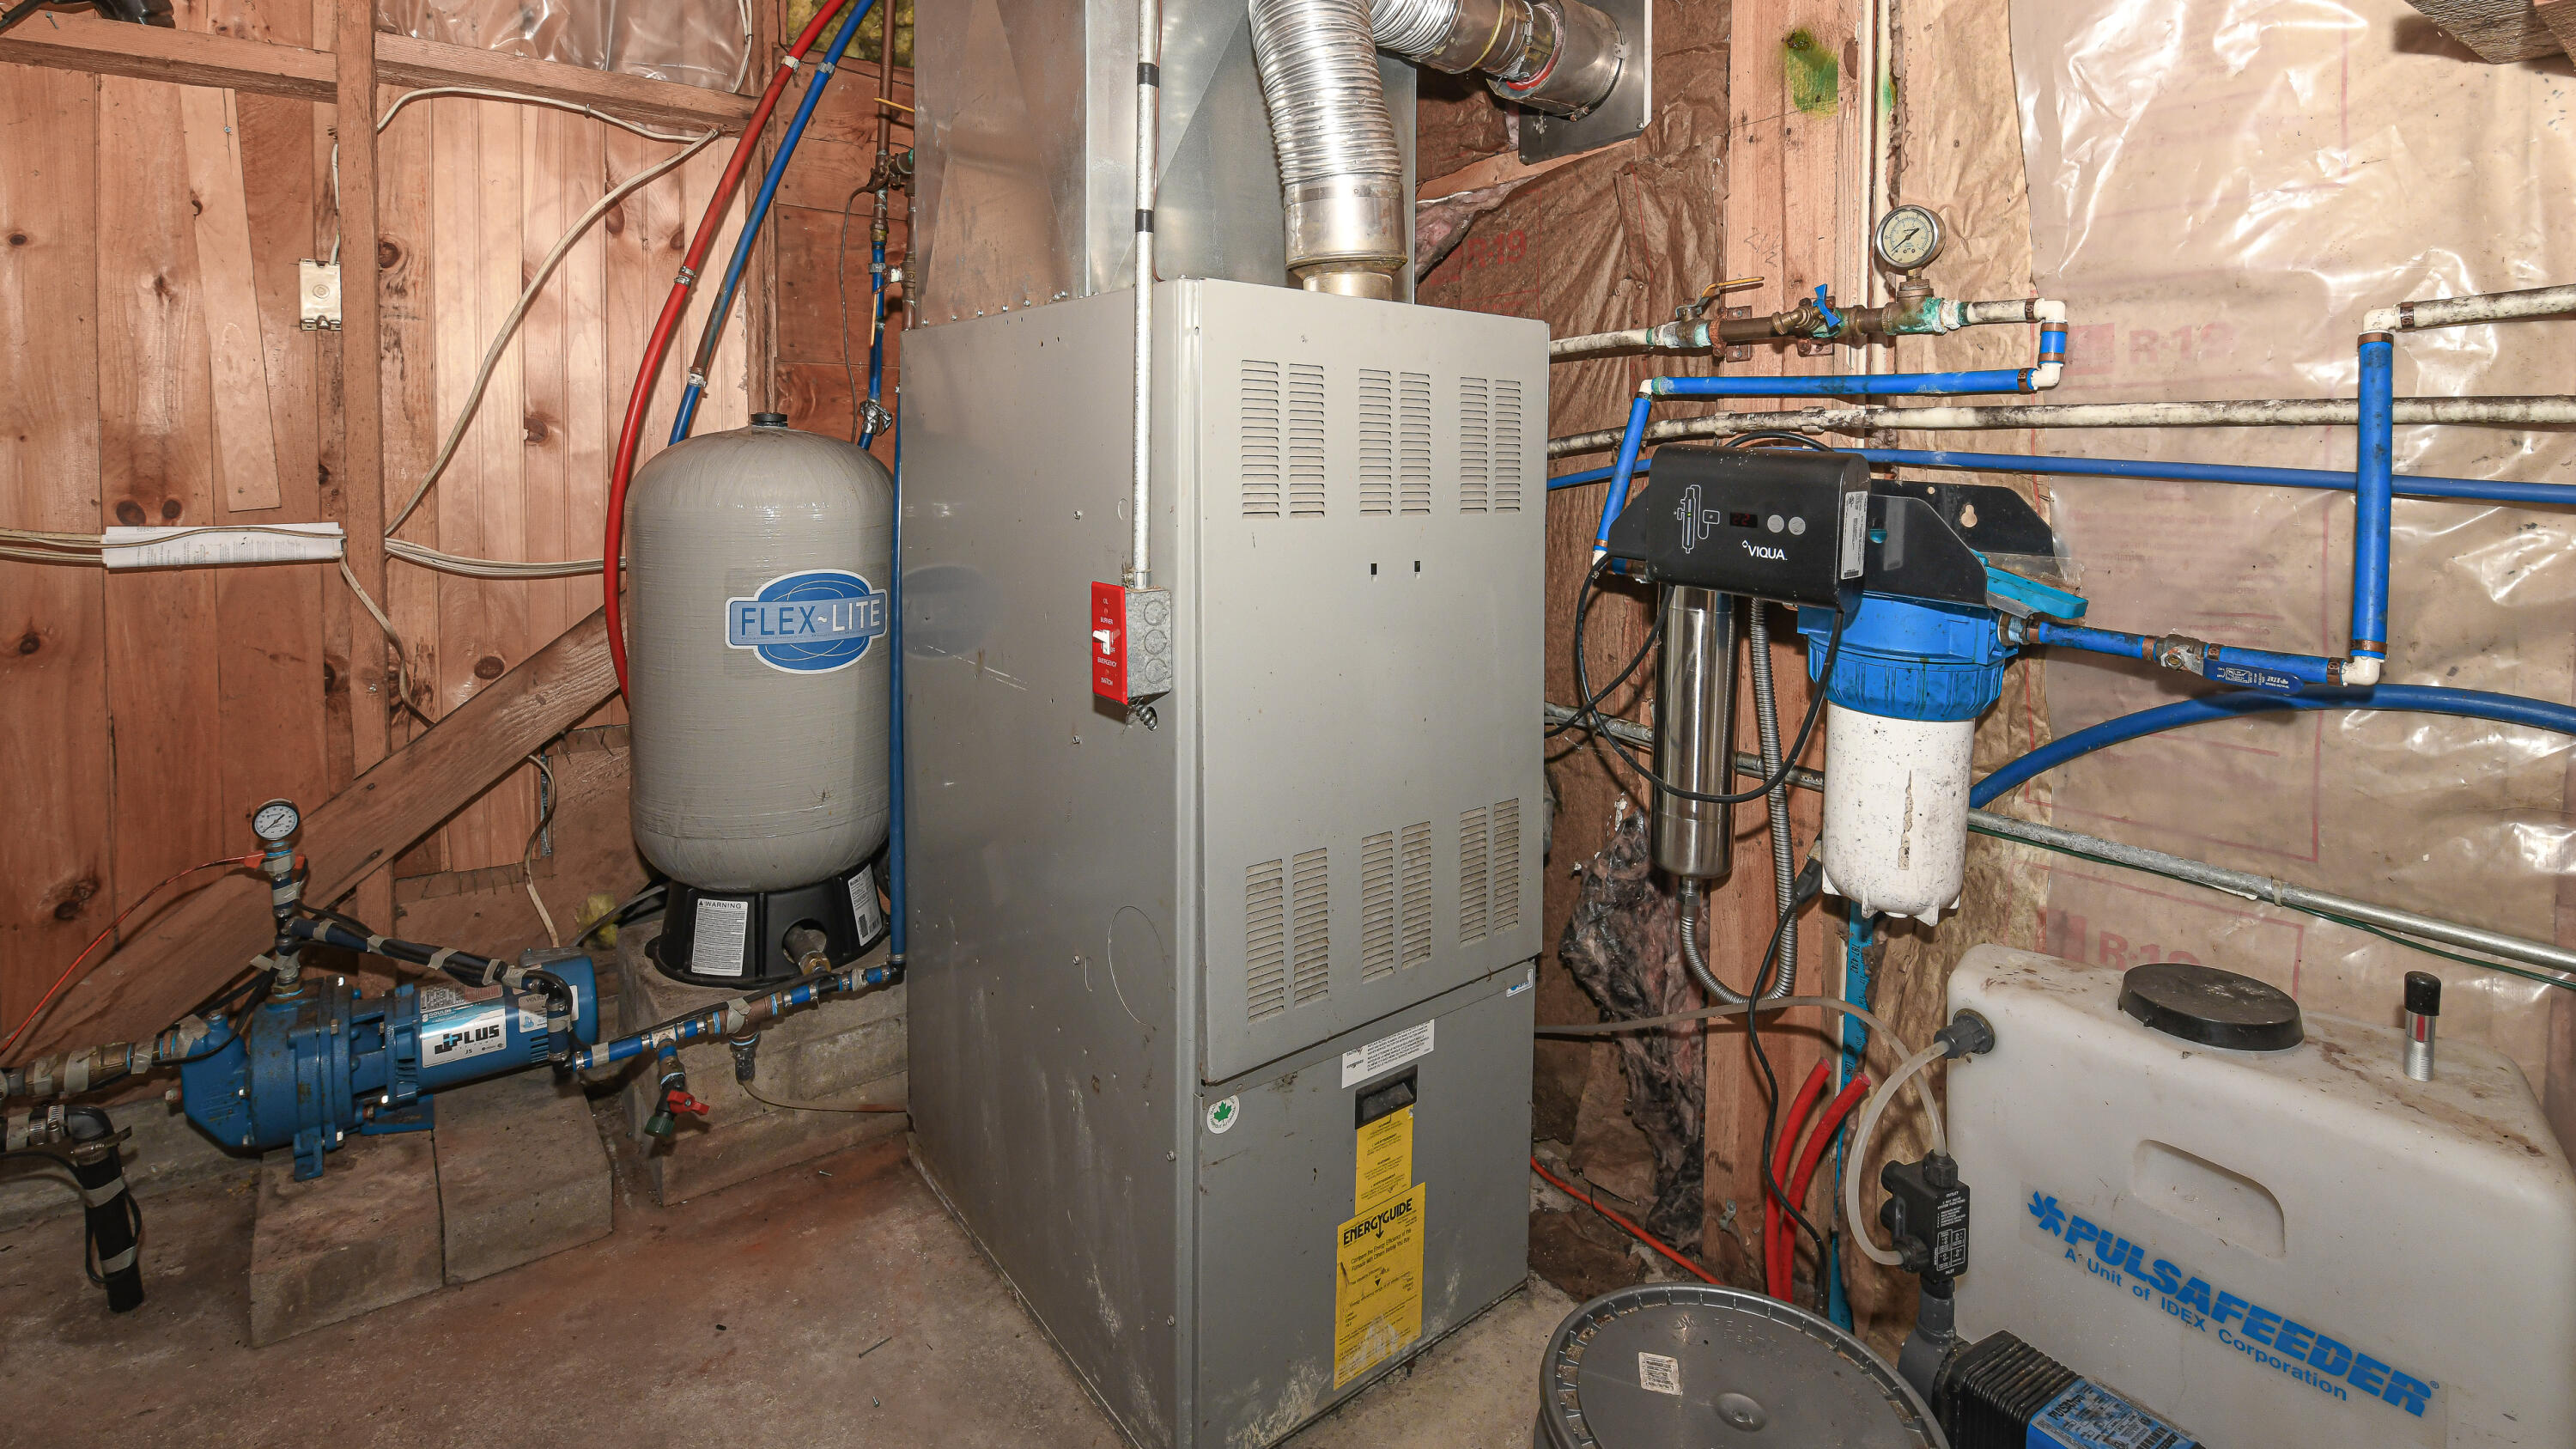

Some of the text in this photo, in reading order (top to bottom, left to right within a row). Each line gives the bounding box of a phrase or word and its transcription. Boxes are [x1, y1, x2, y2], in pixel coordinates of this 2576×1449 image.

[1466, 229, 1527, 271] R-19
[1748, 545, 1786, 561] VIQUA
[1100, 615, 1114, 625] BURNER
[1097, 655, 1117, 667] EMERGENCY
[1100, 676, 1114, 686] SWITCH
[705, 900, 743, 910] WARNING
[1343, 1197, 1413, 1246] ENERGYGUIDE
[2063, 1214, 2433, 1418] PULSAFEEDER
[2065, 1248, 2348, 1402] A Unit of IDEX Corporation
